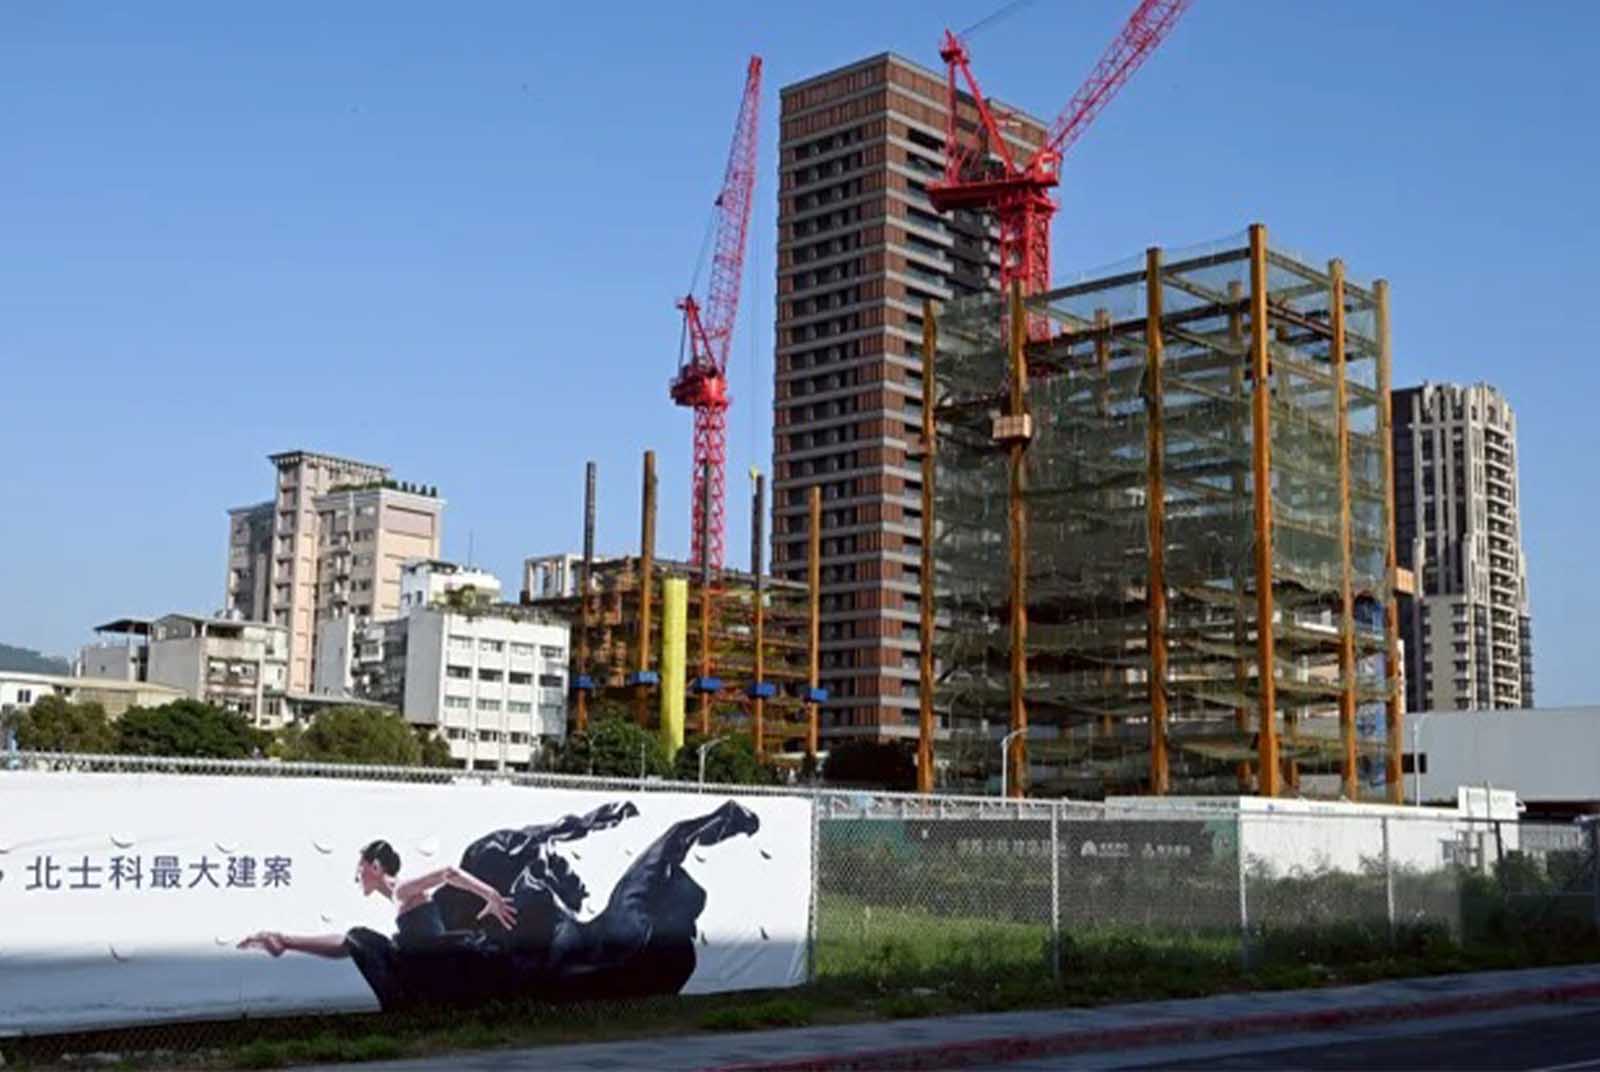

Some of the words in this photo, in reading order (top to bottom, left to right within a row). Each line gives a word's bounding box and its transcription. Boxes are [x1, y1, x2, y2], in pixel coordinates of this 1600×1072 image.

[25, 855, 293, 890] 北士科最大建案
